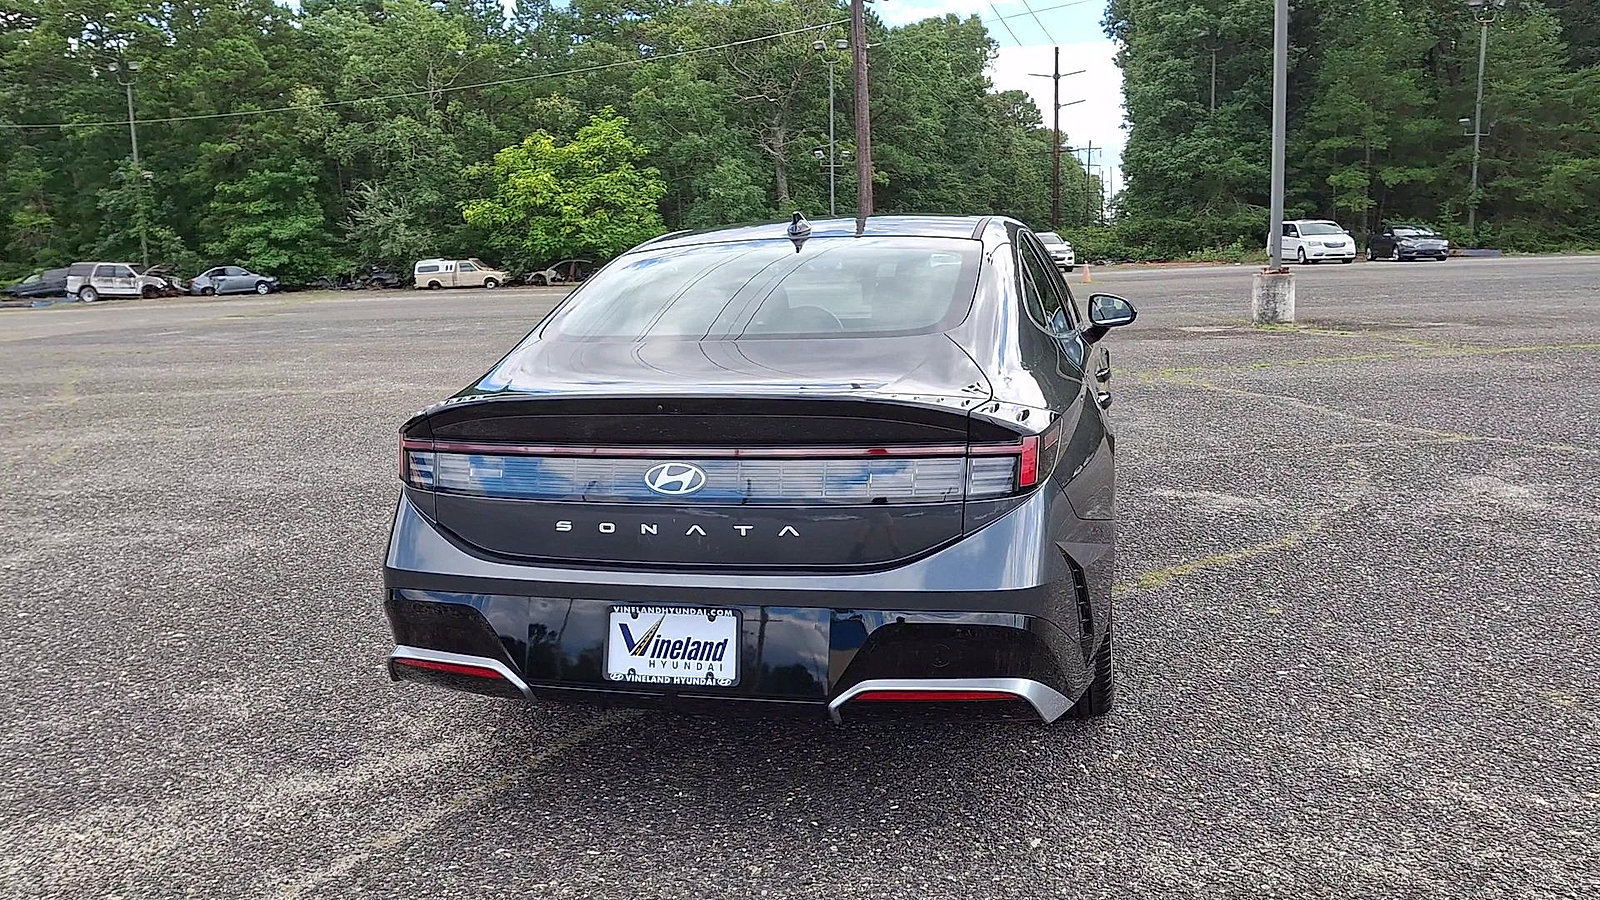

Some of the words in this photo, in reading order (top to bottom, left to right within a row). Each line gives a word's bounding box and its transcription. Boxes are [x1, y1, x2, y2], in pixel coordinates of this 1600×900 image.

[555, 520, 800, 537] SONATA
[613, 605, 733, 617] VINELANDHYUNDAI.COM
[618, 613, 729, 662] Vineland
[648, 659, 723, 672] HYUNDAI
[625, 674, 671, 684] VINELAND
[673, 676, 717, 686] HYUNDAI
